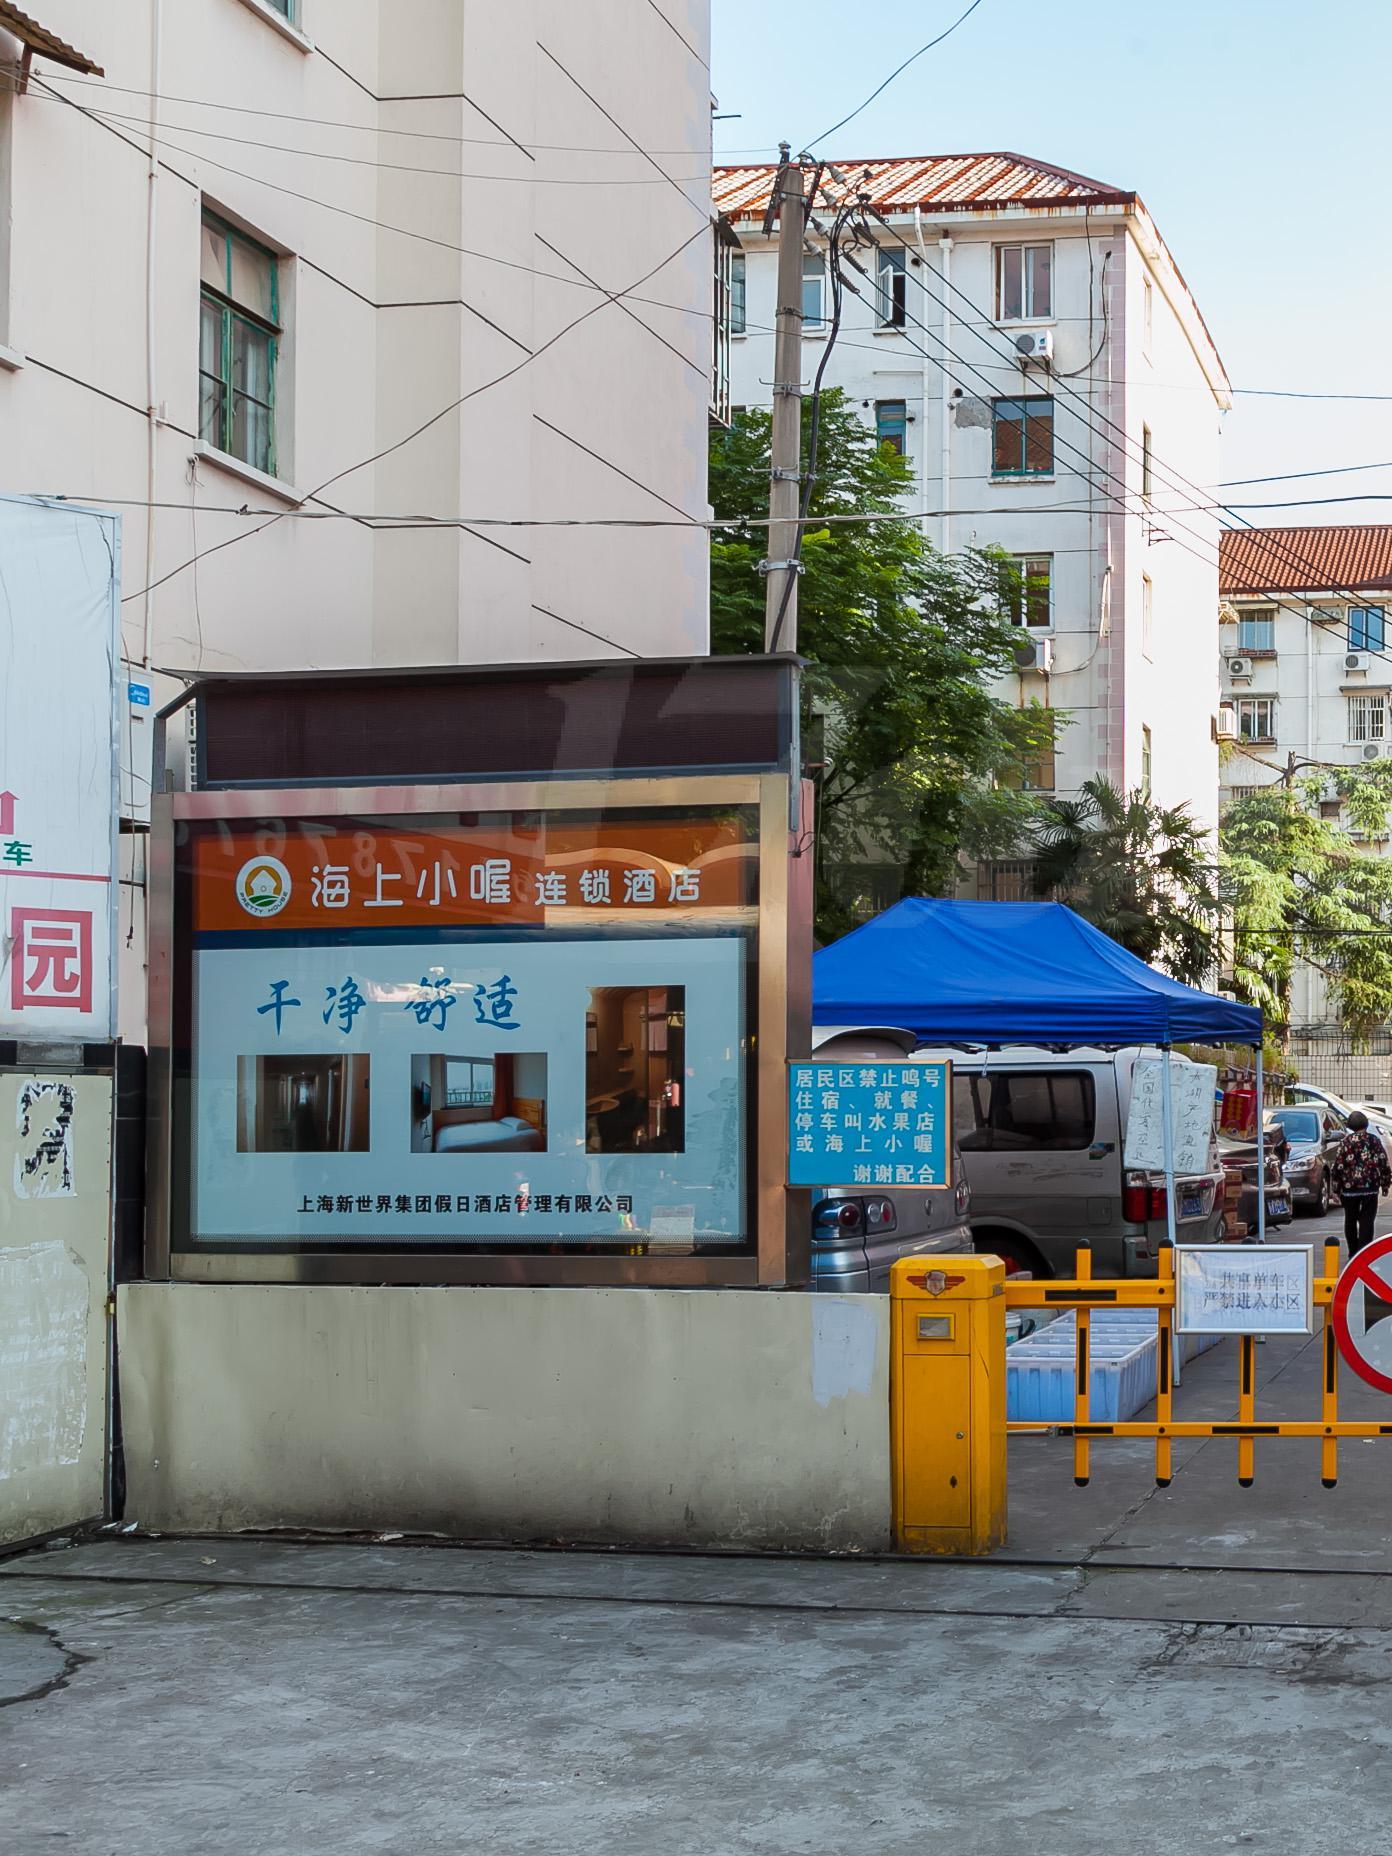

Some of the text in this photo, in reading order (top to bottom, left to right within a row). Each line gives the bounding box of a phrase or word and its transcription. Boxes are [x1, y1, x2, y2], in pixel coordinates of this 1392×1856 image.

[11, 906, 93, 1013] 园
[795, 1069, 941, 1089] 居民区禁止鸣号
[794, 1112, 935, 1132] 停车叫水果店
[796, 1134, 933, 1153] 或海上小喔
[853, 1163, 936, 1184] 谢谢配合
[296, 1194, 634, 1214] 上海新世界集团假日酒店管理有限公司
